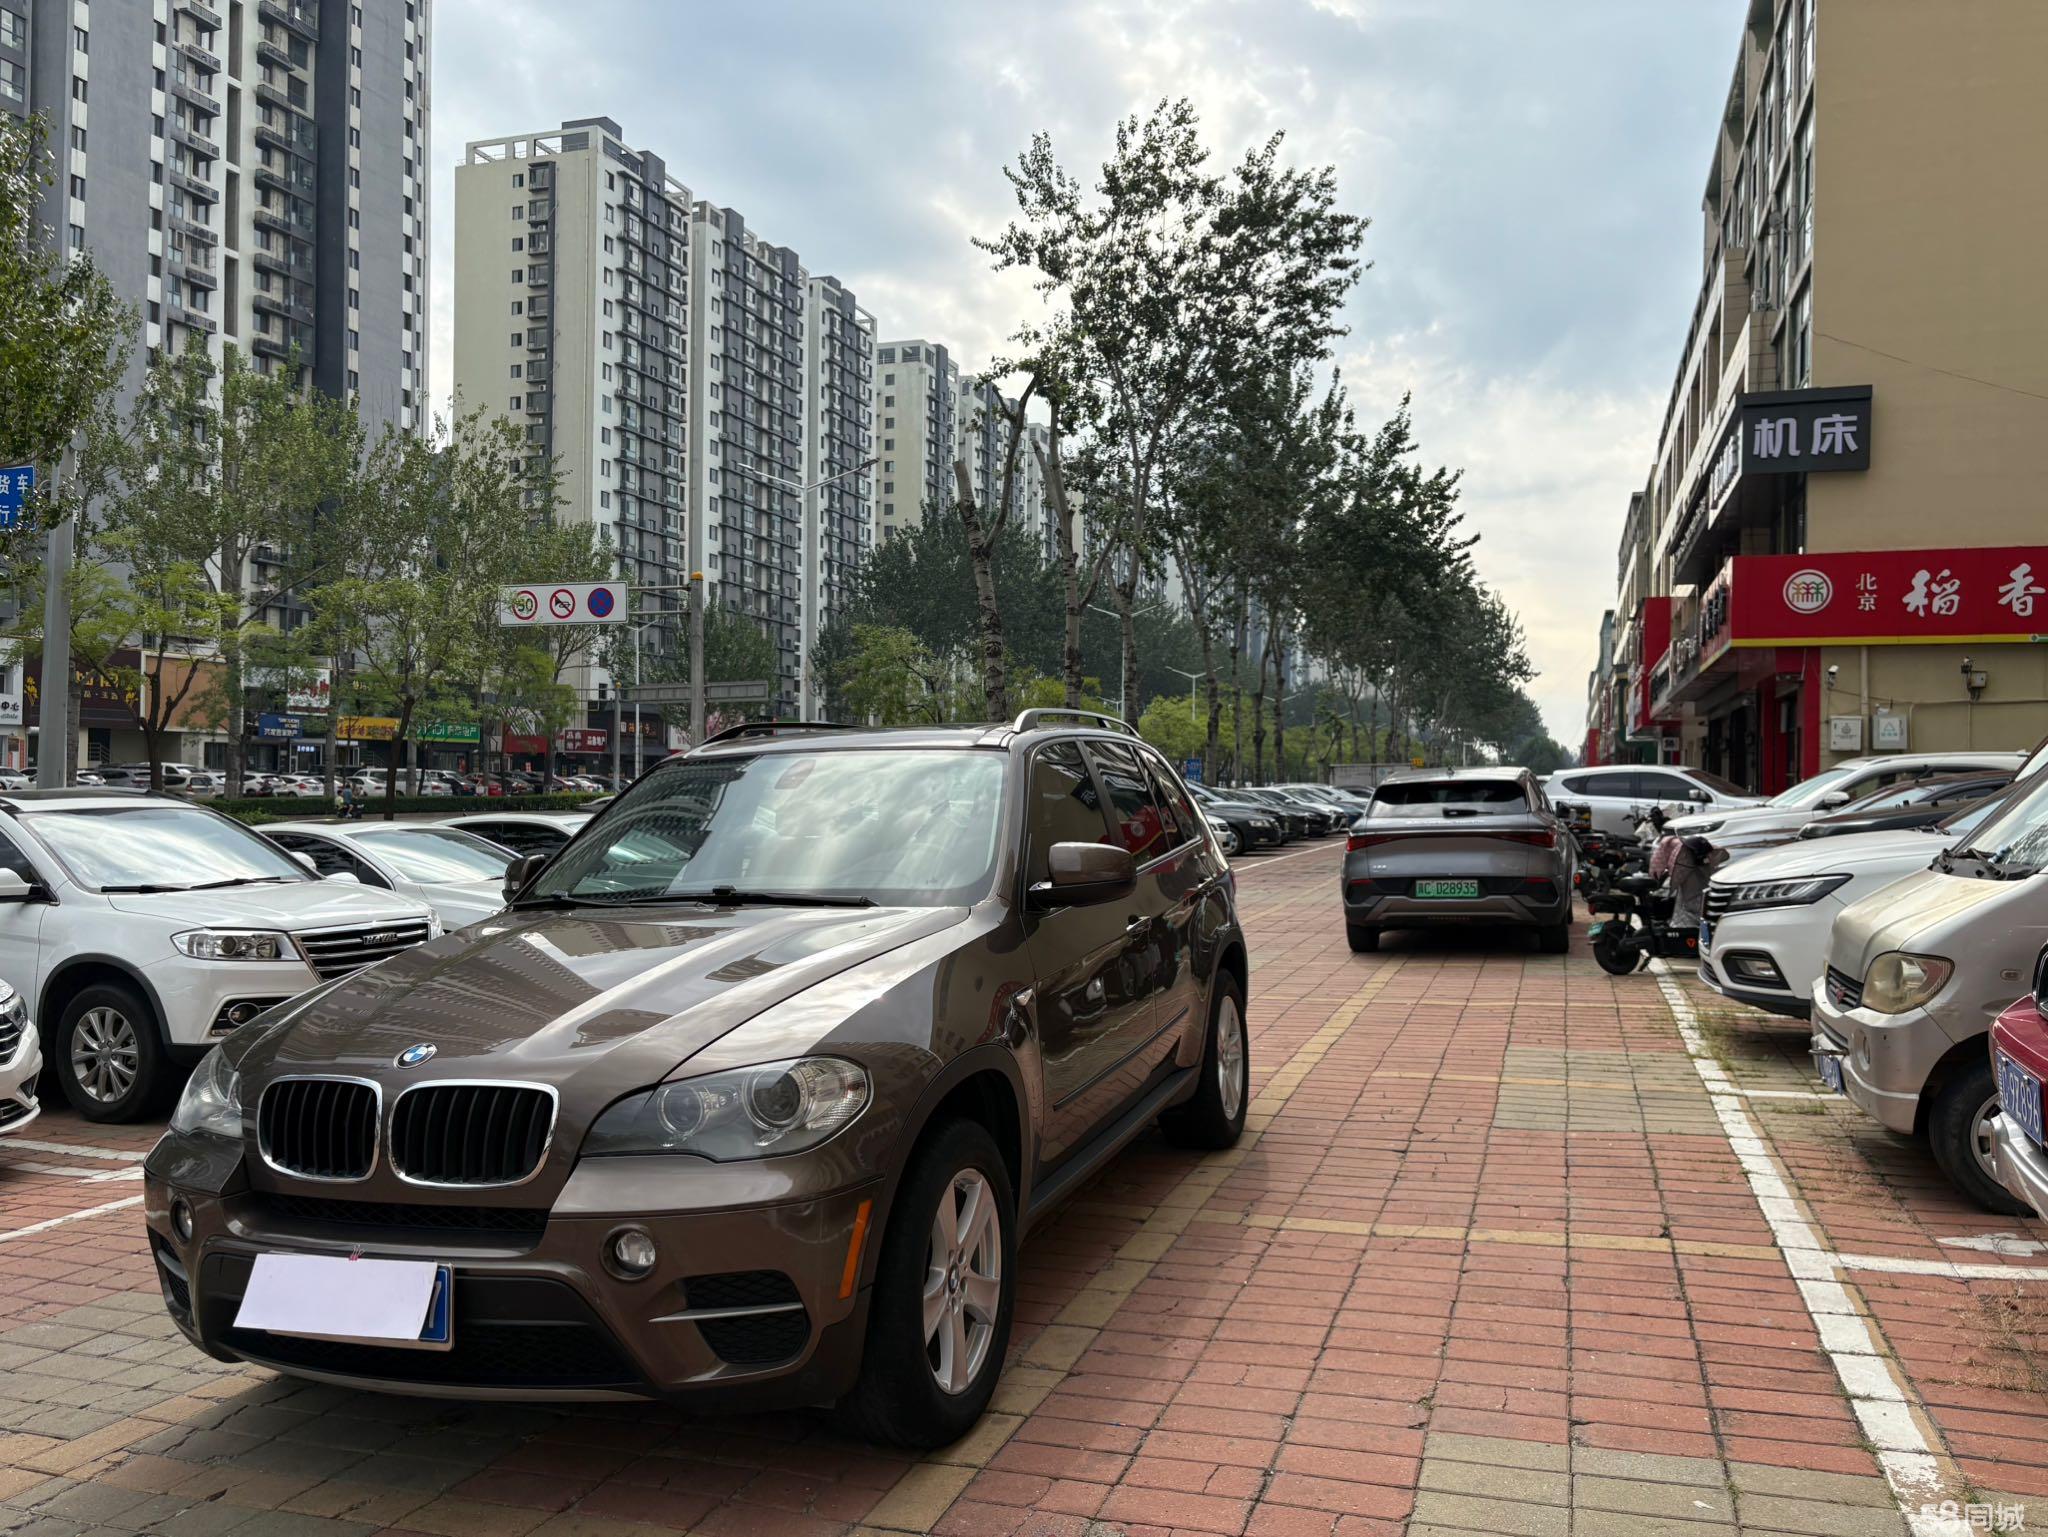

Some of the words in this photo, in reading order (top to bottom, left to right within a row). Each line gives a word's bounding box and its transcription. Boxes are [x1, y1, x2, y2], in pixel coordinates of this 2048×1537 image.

[1752, 413, 1858, 459] 机床
[1856, 573, 1877, 611] 北京
[1902, 562, 2046, 617] 稻香
[1436, 882, 1476, 895] D28935
